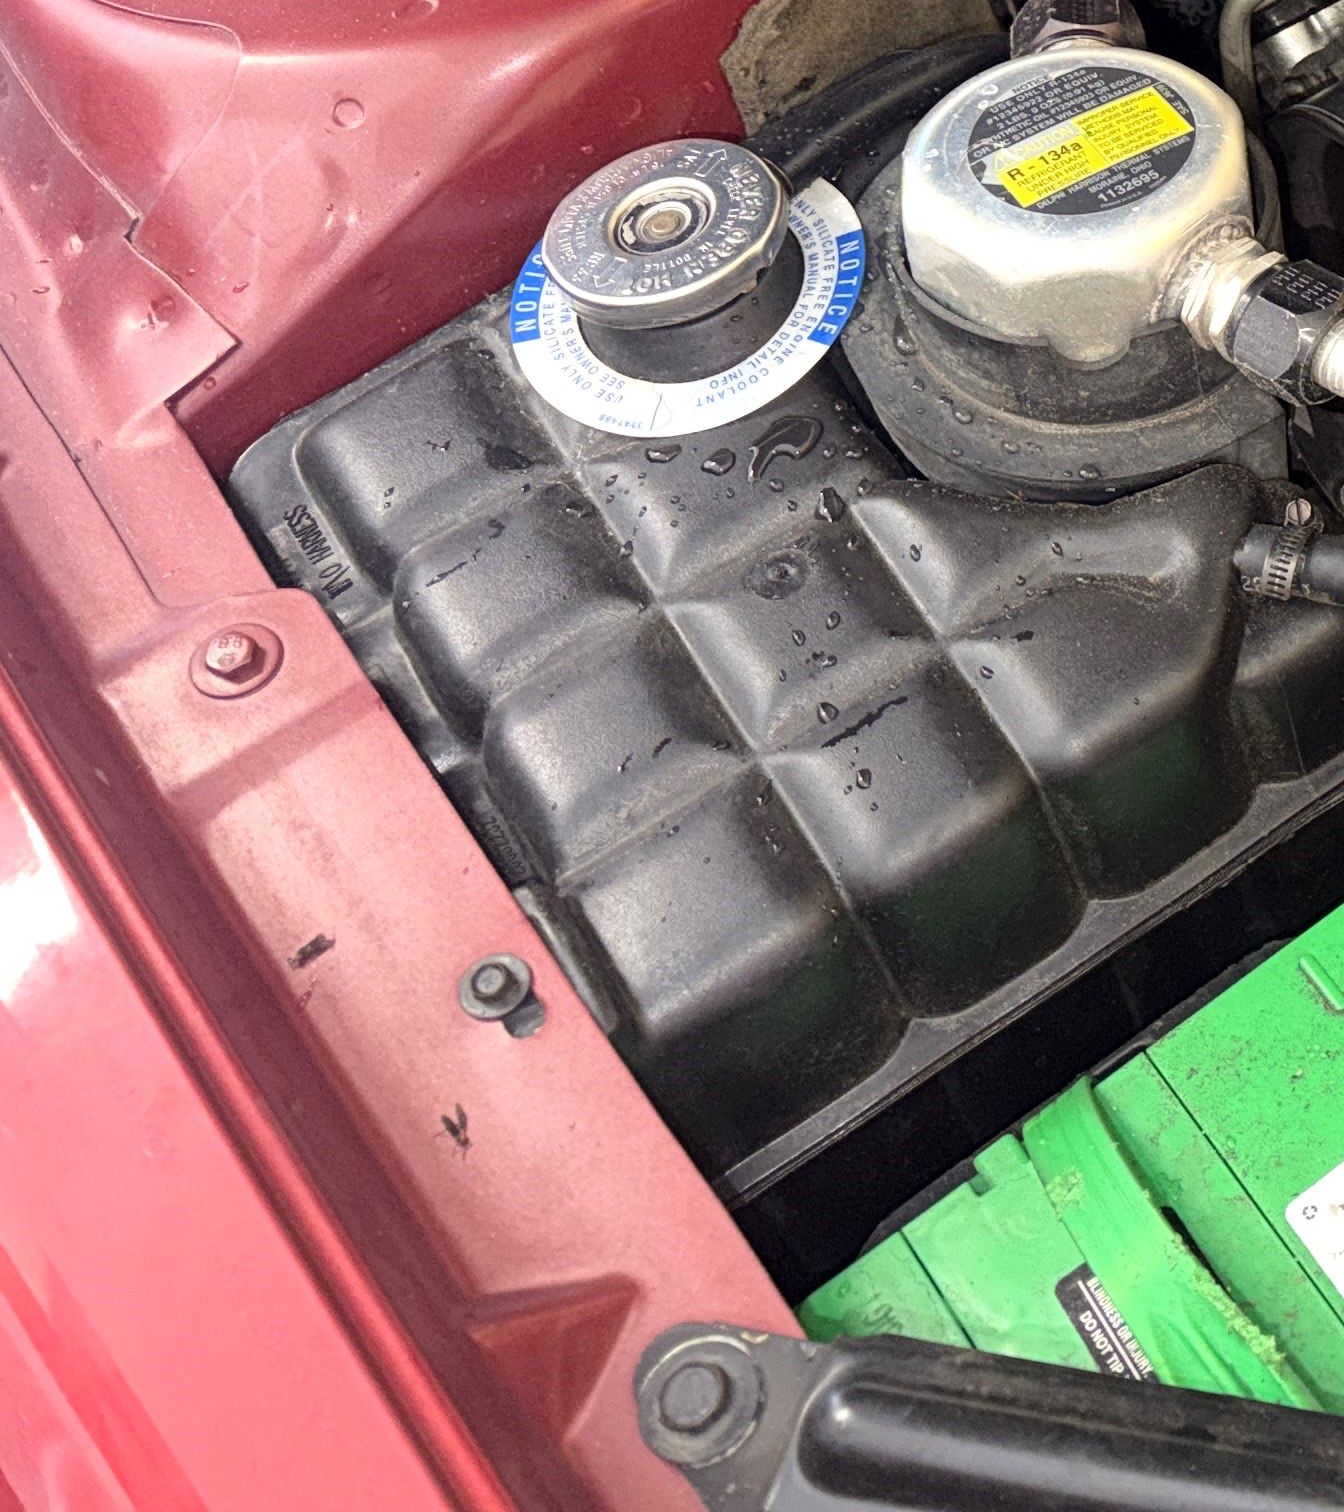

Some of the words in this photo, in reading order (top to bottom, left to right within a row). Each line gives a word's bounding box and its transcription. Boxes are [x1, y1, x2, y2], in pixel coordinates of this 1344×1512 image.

[1009, 117, 1057, 141] SYSTEM
[1054, 106, 1081, 121] WILL
[1097, 75, 1152, 104] DAMAGED
[1014, 84, 1047, 102] ONLY
[1011, 124, 1075, 158] CAUTION
[1004, 166, 1026, 181] R
[1036, 139, 1084, 166] 134a
[1015, 150, 1089, 187] REFRIGERANT
[1024, 170, 1065, 192] UNDER
[1062, 157, 1091, 174] HIGH
[1111, 151, 1152, 173] THERMAL
[1095, 168, 1161, 203] 1132695
[813, 218, 836, 271] SILICATE
[515, 253, 546, 334] NOTIC
[802, 252, 819, 300] MANUAL
[813, 278, 834, 310] FREE
[817, 239, 861, 335] NOTICE
[543, 303, 565, 361] SILICATE
[788, 304, 808, 329] FOR
[747, 331, 791, 369] DETAIL
[561, 364, 592, 391] ONLY
[600, 373, 626, 390] SEE
[696, 367, 769, 407] COOLANT
[710, 368, 744, 390] INFO
[1086, 1276, 1124, 1328] BLINDNESS
[1117, 1325, 1133, 1343] OR
[1079, 1310, 1097, 1331] DO
[1090, 1329, 1113, 1355] NOT
